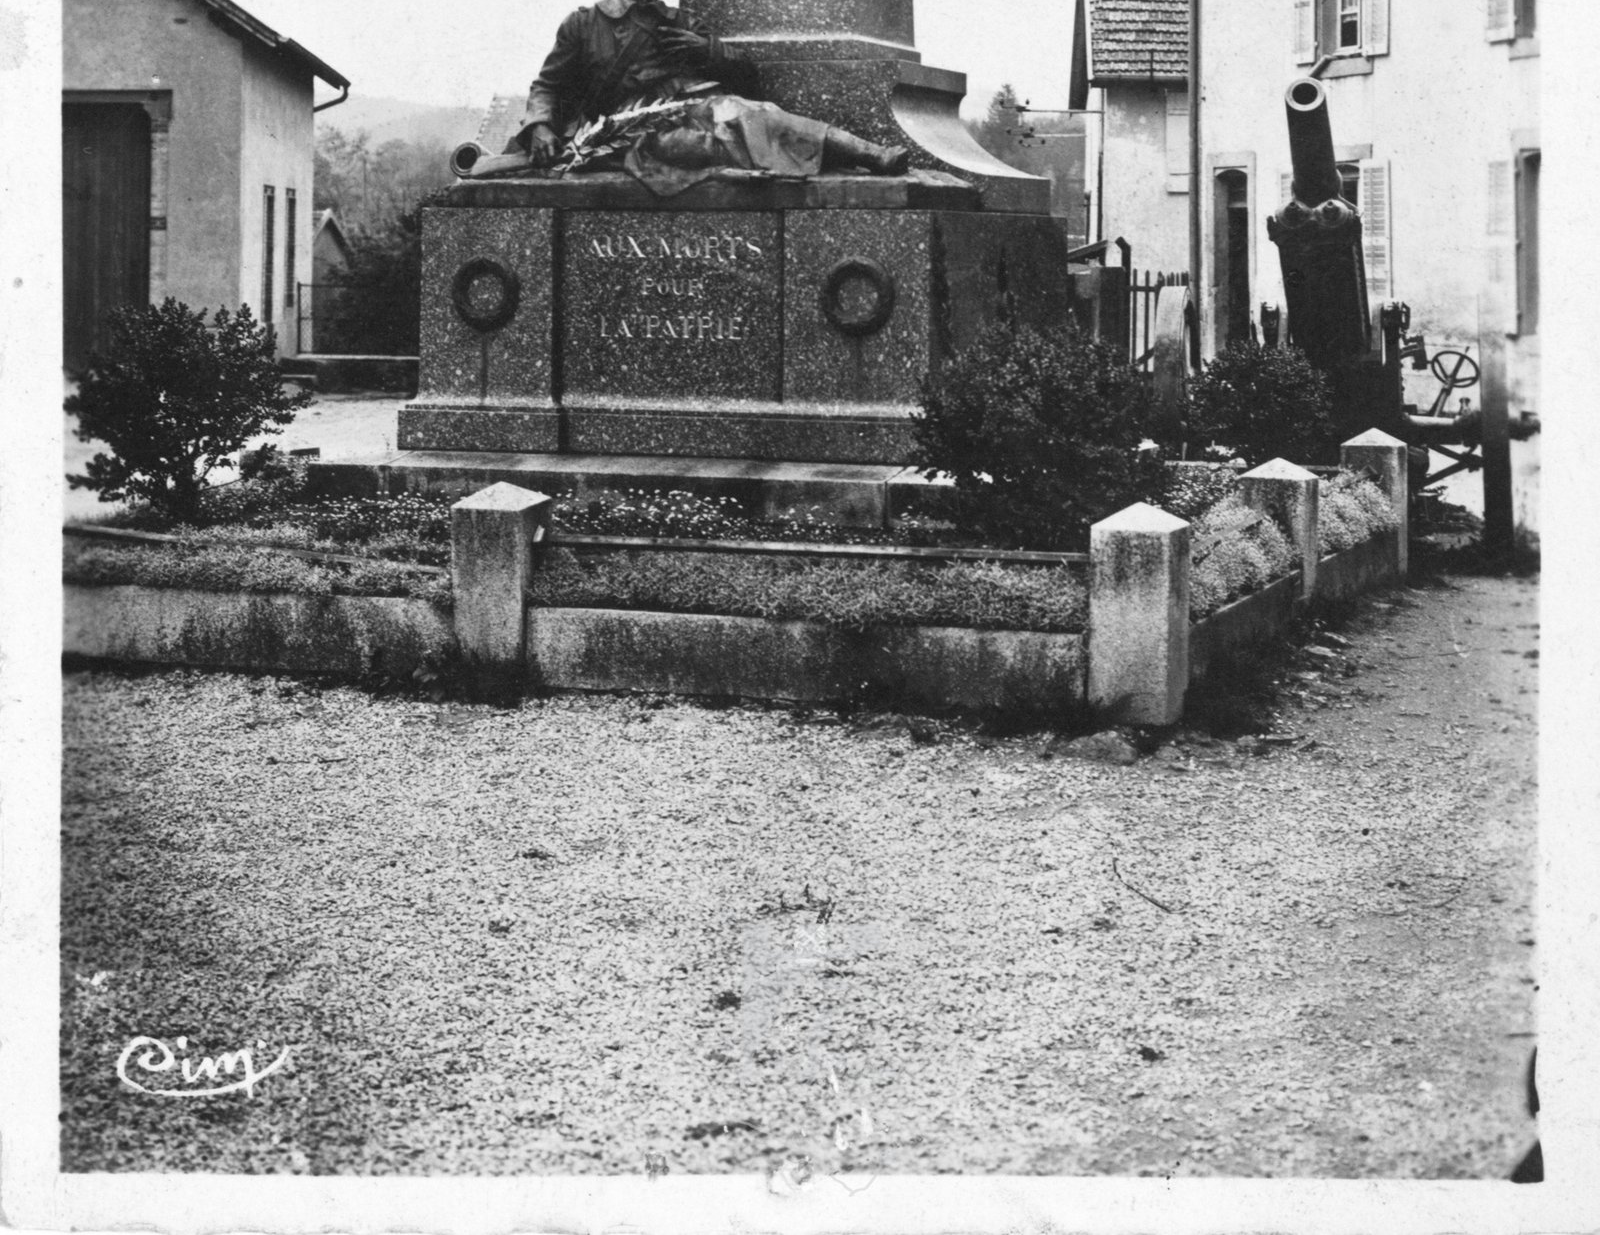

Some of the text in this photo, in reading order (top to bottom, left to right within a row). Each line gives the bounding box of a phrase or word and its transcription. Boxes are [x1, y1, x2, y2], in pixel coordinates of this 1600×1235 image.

[589, 235, 762, 262] AUX MORTS
[641, 277, 704, 298] POUR
[601, 315, 742, 342] LA PATRIE
